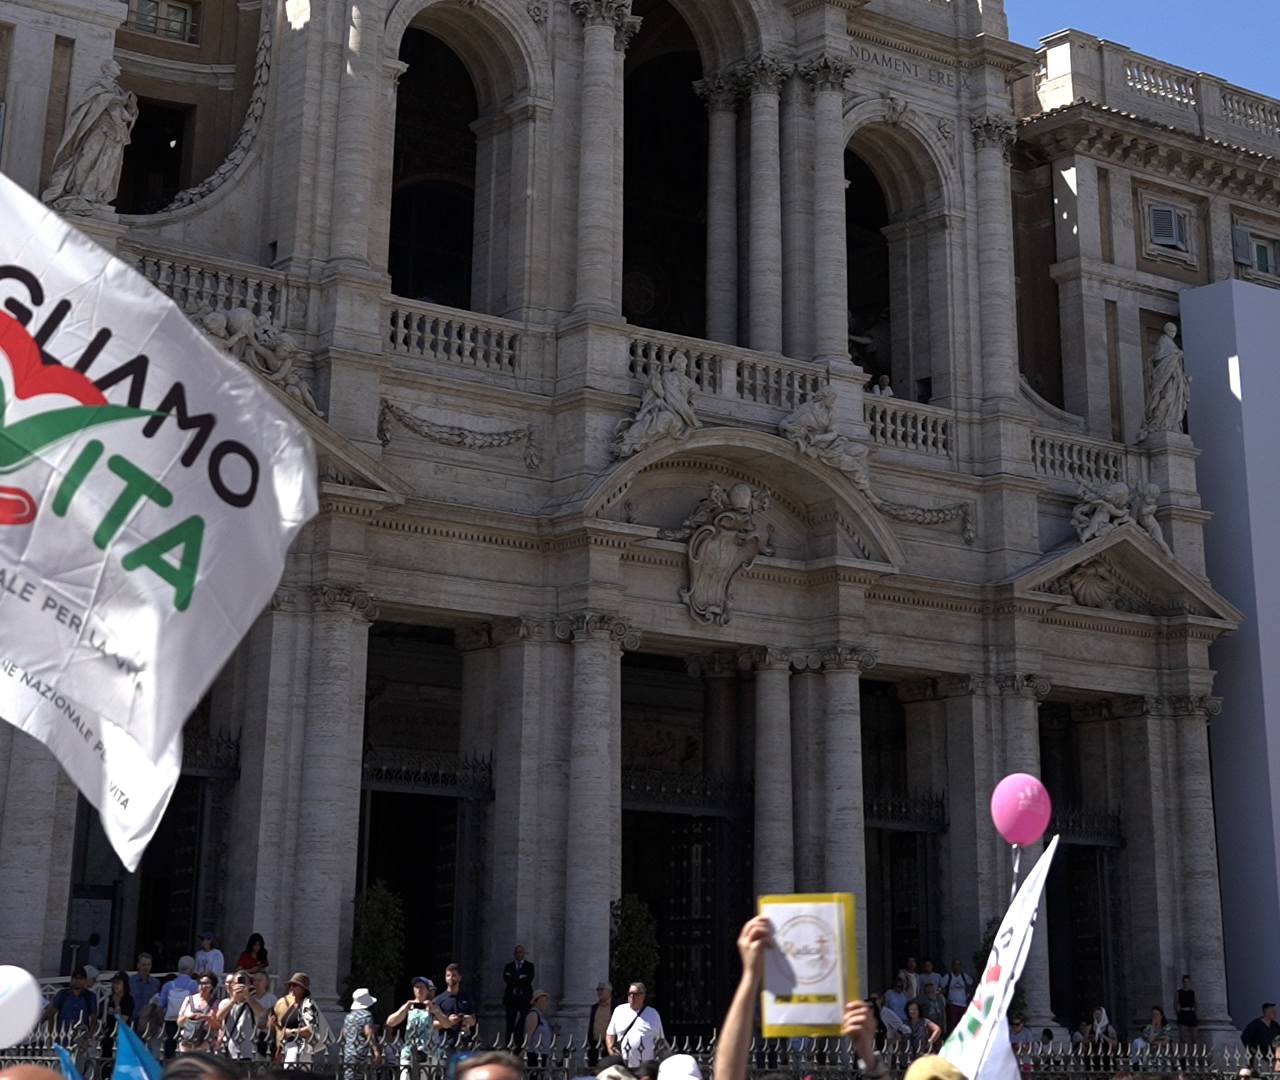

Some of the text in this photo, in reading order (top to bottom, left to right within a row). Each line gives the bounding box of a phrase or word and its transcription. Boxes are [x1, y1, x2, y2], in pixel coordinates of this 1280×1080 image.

[41, 595, 83, 634] PER
[20, 672, 94, 742] NAZIONALE
[109, 781, 130, 810] VITA
